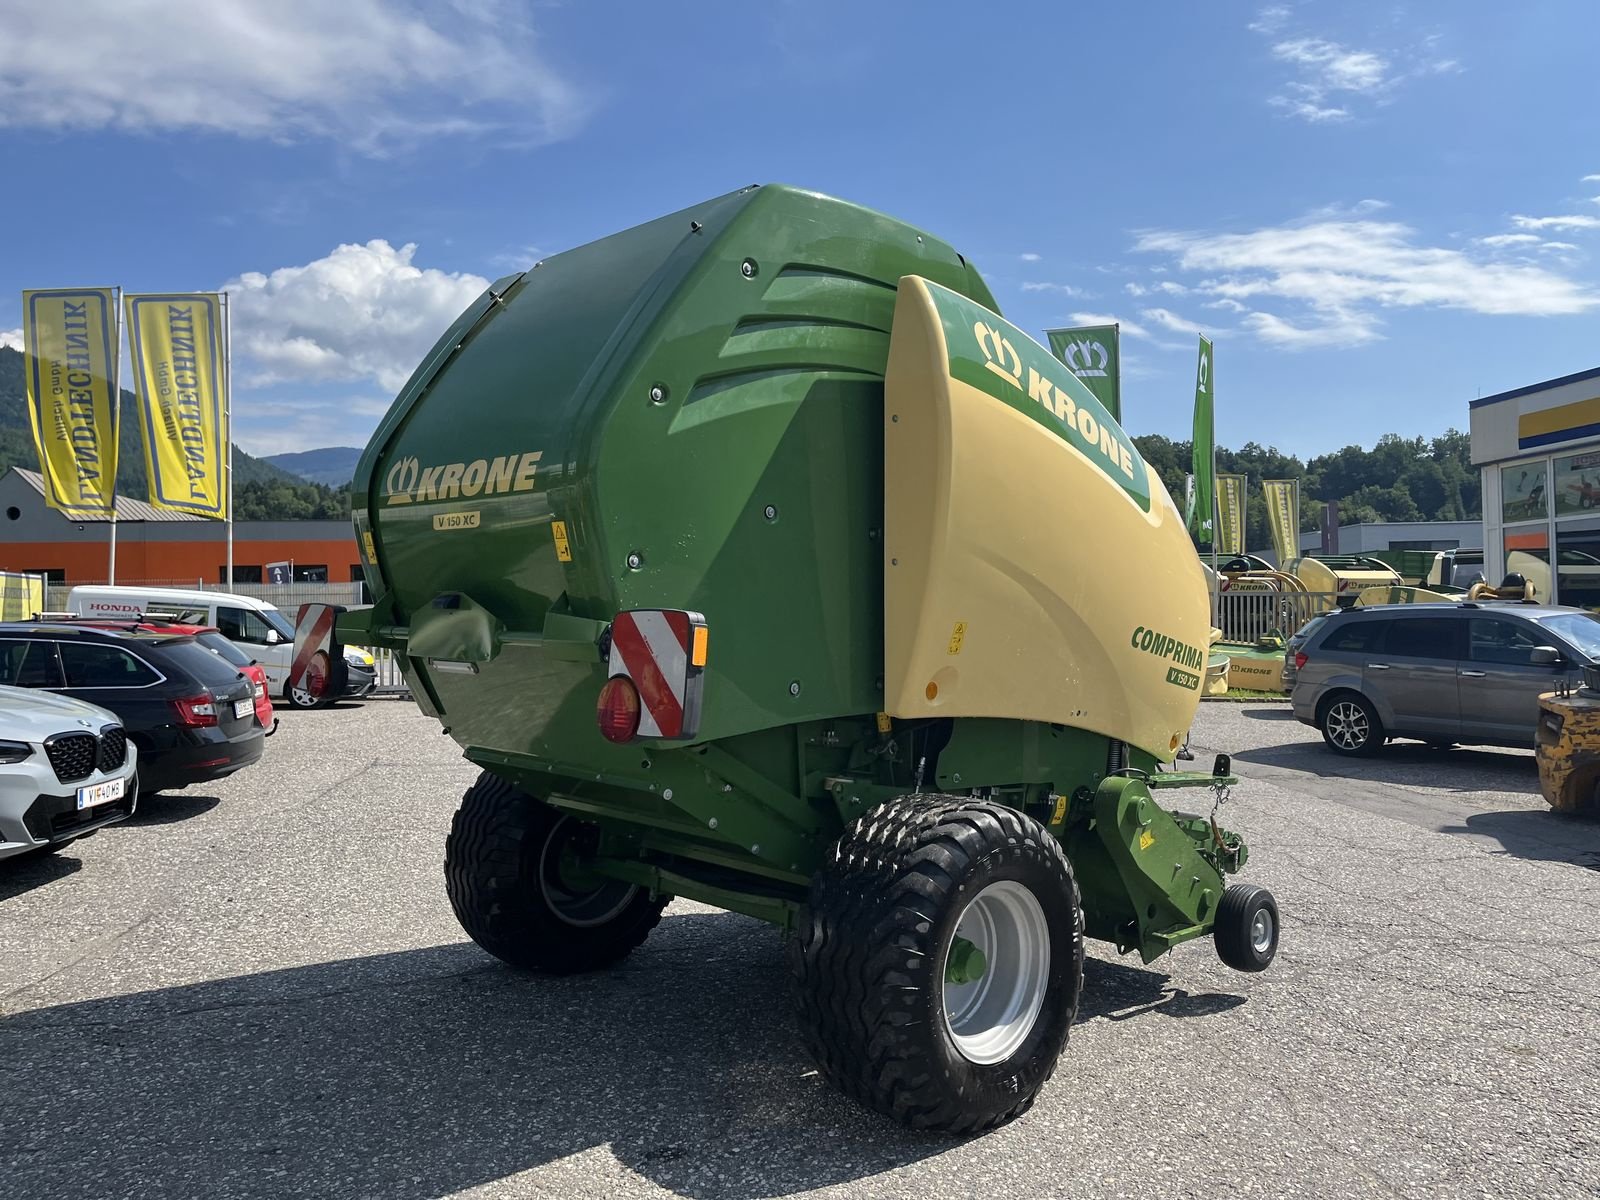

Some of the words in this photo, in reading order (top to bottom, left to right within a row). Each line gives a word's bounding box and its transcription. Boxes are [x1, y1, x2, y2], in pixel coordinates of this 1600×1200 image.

[1028, 366, 1134, 480] KRONE
[416, 451, 543, 502] KRONE
[438, 516, 445, 528] V
[447, 515, 461, 527] 150
[463, 514, 475, 526] XC
[1239, 584, 1270, 592] KRONE
[89, 603, 142, 613] HONDA
[1131, 626, 1203, 672] COMPRIMA
[1170, 670, 1177, 681] V
[1177, 673, 1188, 685] 150
[1187, 677, 1197, 688] XC
[1240, 667, 1273, 675] KRONE
